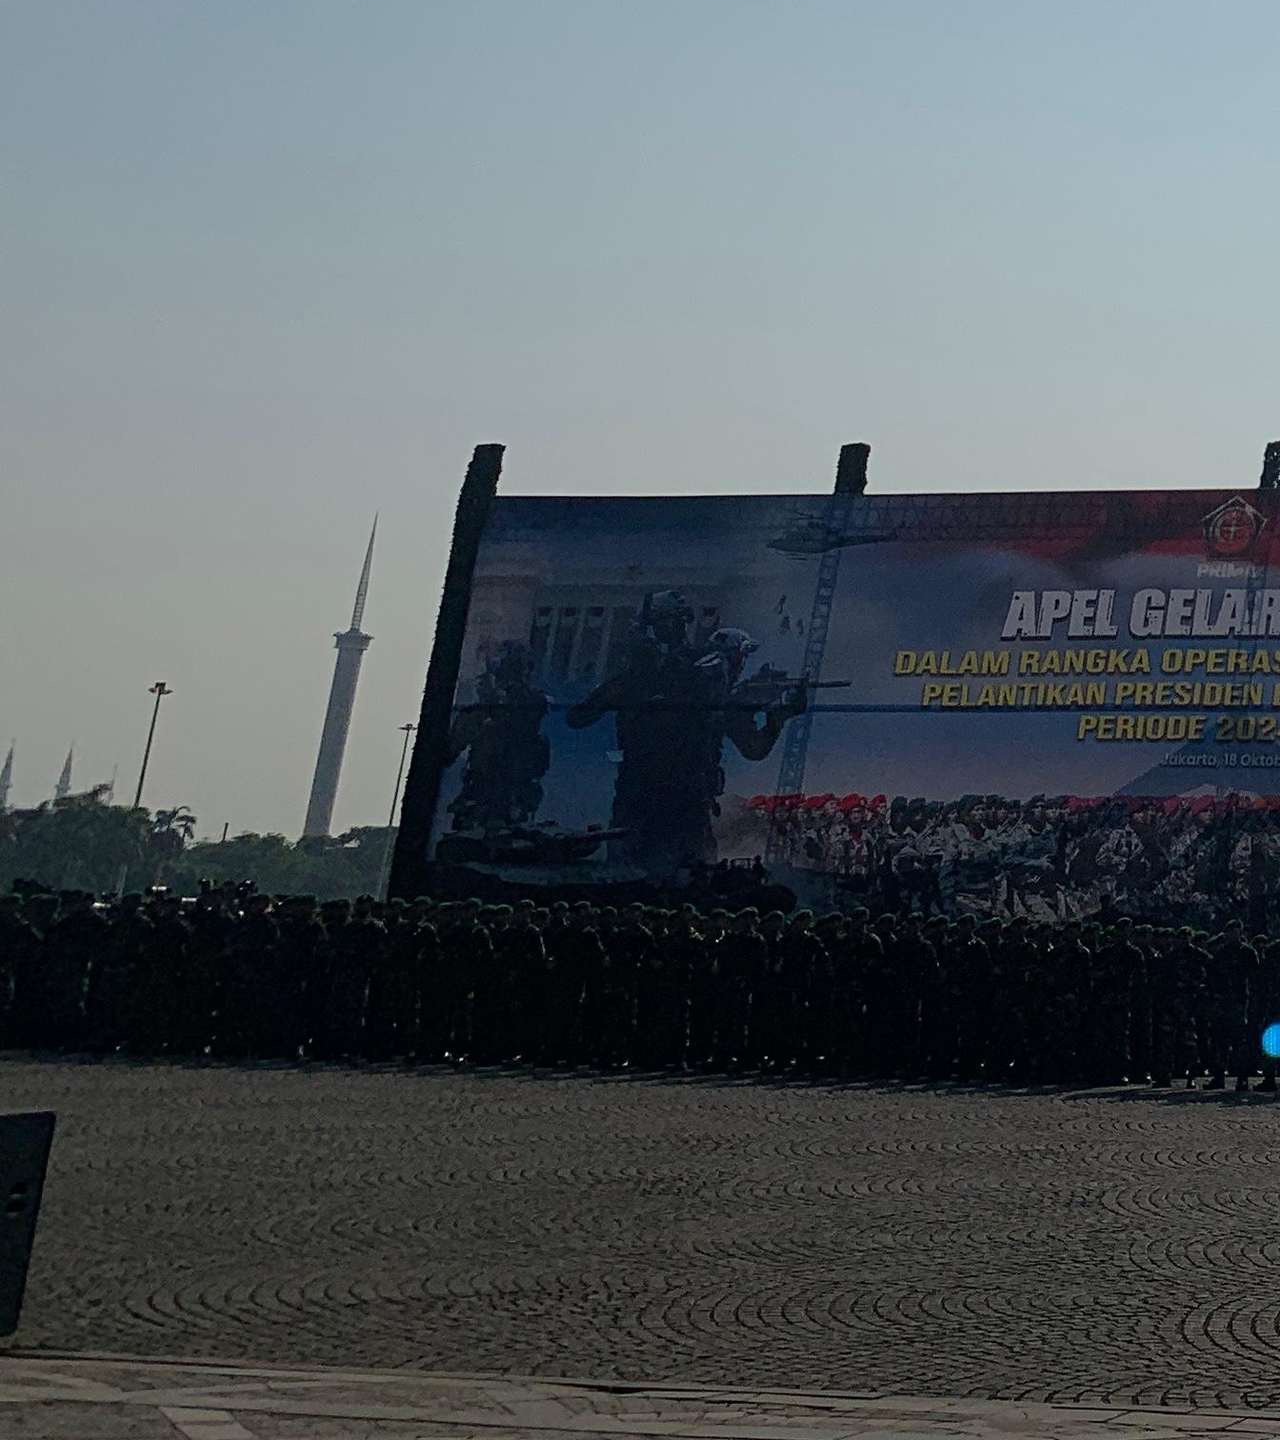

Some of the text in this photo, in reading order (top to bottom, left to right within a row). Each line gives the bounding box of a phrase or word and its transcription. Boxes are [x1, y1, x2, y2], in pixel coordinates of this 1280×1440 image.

[1001, 589, 1118, 641] APEL
[894, 649, 1011, 677] DALAM
[1018, 648, 1151, 676] RANGKA
[922, 682, 1107, 709] PELANTIKAN
[1114, 681, 1264, 708] PRESIDEN
[1077, 715, 1208, 742] PERIODE
[1160, 753, 1221, 768] Jakarta,
[1224, 753, 1237, 768] 18
